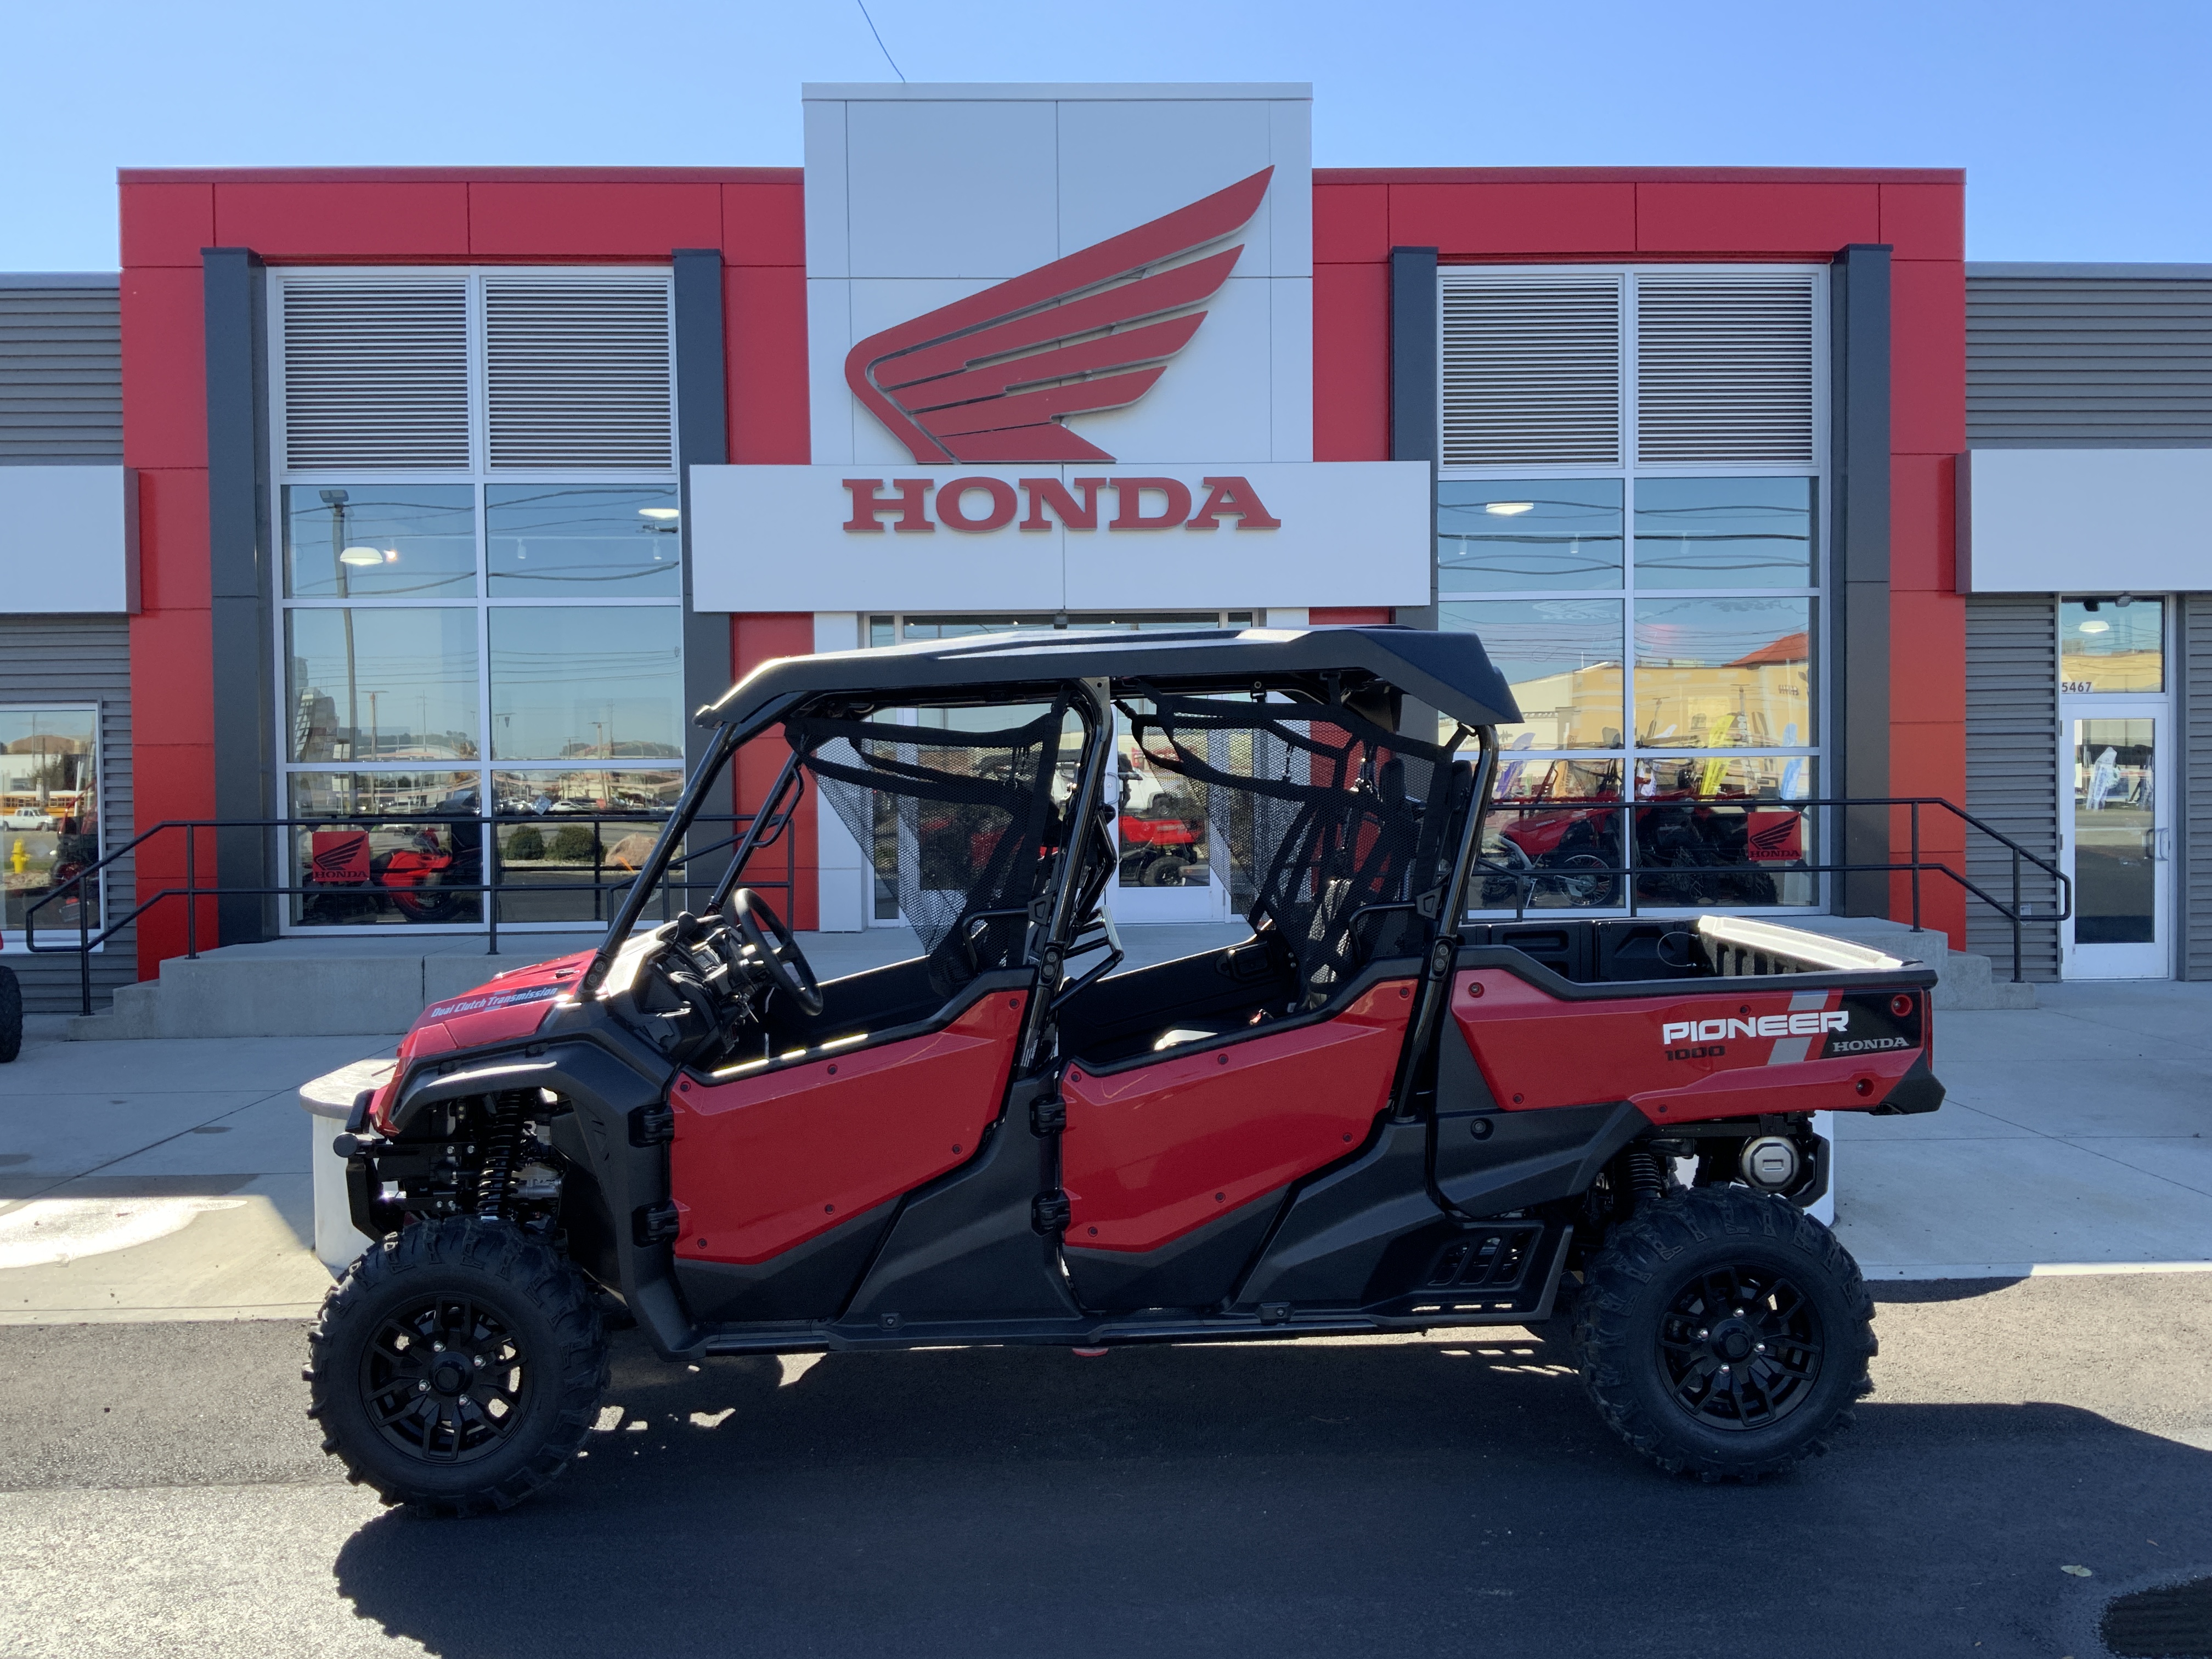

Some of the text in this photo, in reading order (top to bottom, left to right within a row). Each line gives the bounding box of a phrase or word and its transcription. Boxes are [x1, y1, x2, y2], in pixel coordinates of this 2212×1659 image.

[842, 476, 1282, 532] HONDA
[2062, 682, 2092, 692] 5467
[431, 988, 558, 1018] Dual Clutch Transmission
[1663, 1011, 1849, 1045] PIONEER
[1665, 1045, 1725, 1061] 1000
[1833, 1037, 1909, 1052] HONDA
